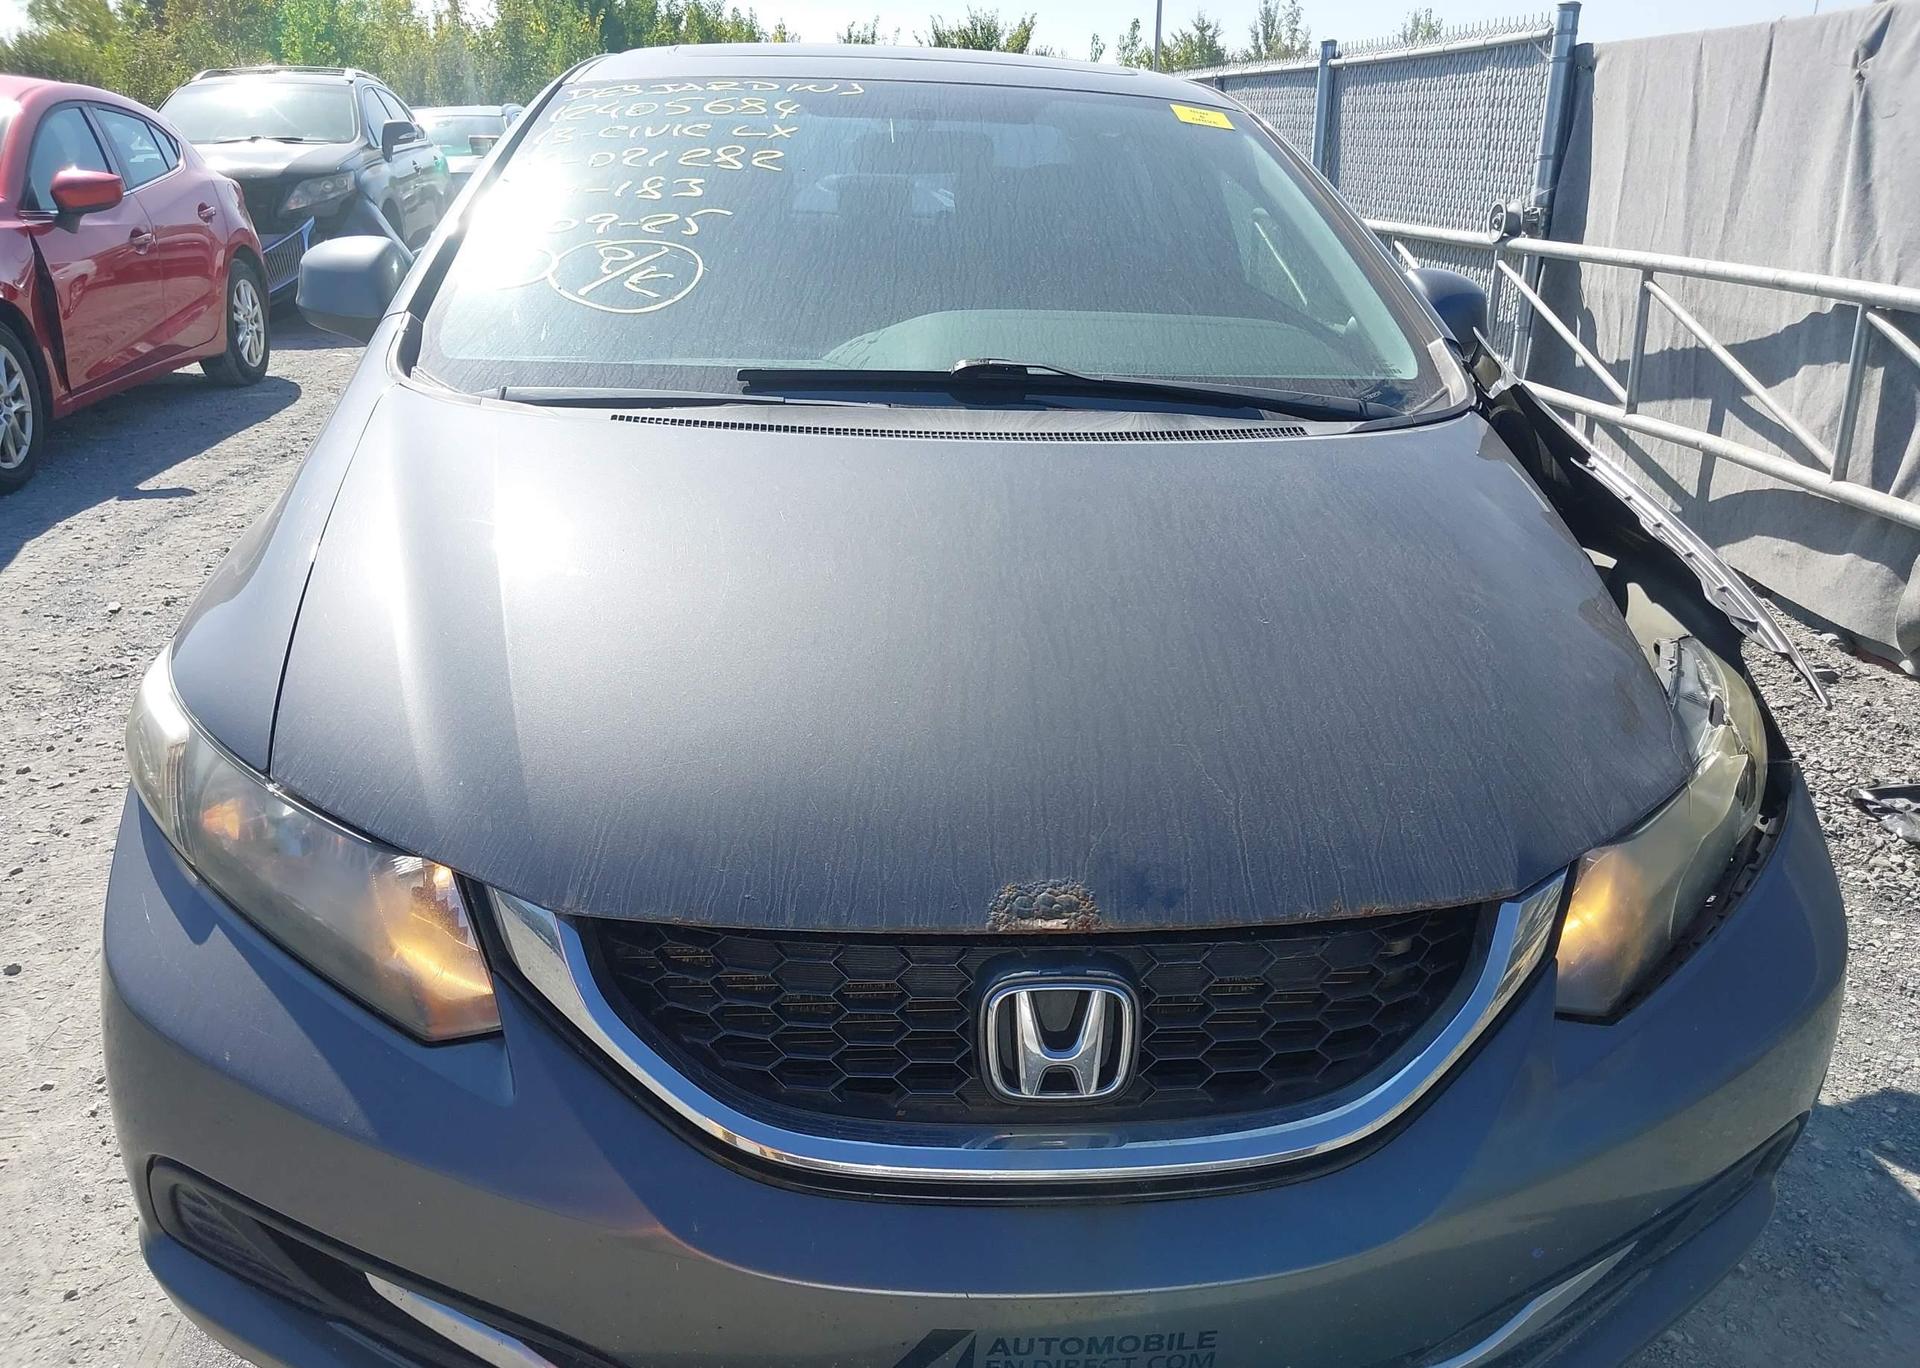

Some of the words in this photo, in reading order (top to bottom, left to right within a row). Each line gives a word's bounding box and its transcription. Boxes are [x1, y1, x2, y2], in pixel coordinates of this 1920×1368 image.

[731, 124, 799, 140] LX
[546, 145, 785, 172] -021282
[986, 1330, 1218, 1357] AUTOMOBILE
